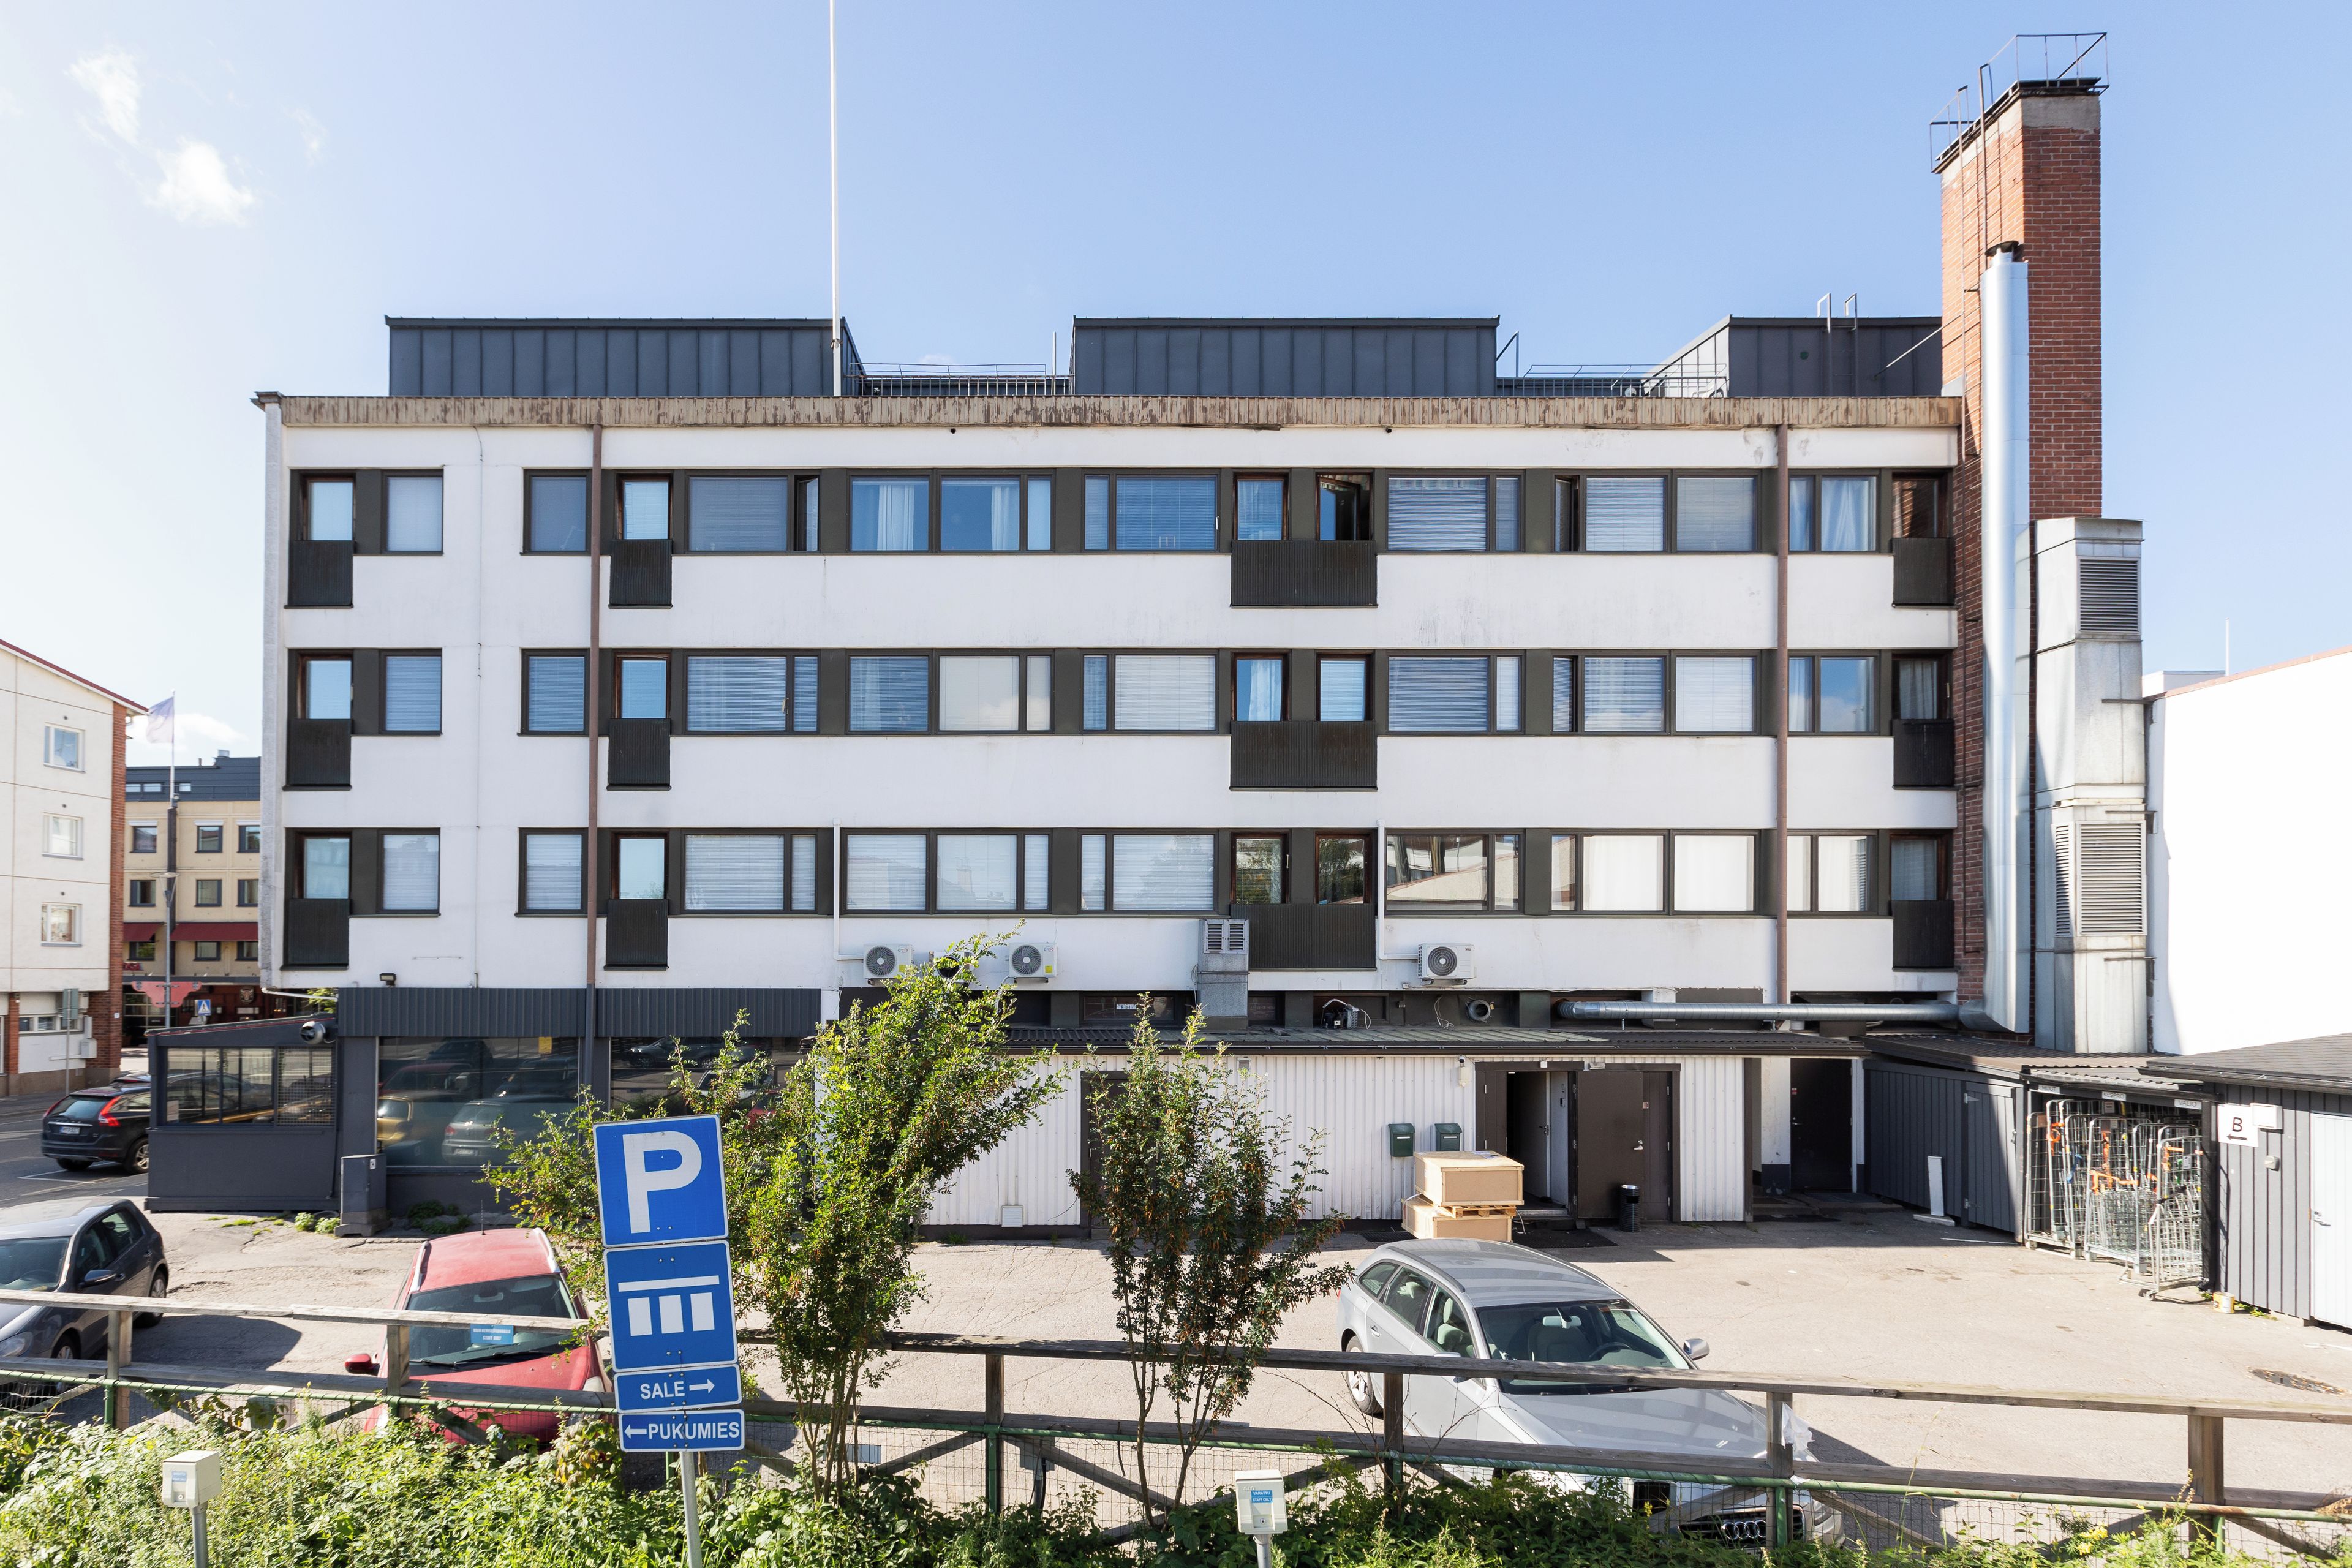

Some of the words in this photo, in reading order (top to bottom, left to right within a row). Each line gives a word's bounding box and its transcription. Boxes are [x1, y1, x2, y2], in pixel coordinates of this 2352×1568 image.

[2232, 1117, 2242, 1132] B
[622, 1131, 703, 1234] P
[640, 1381, 685, 1400] SALE
[648, 1422, 740, 1439] PUKUMIES
